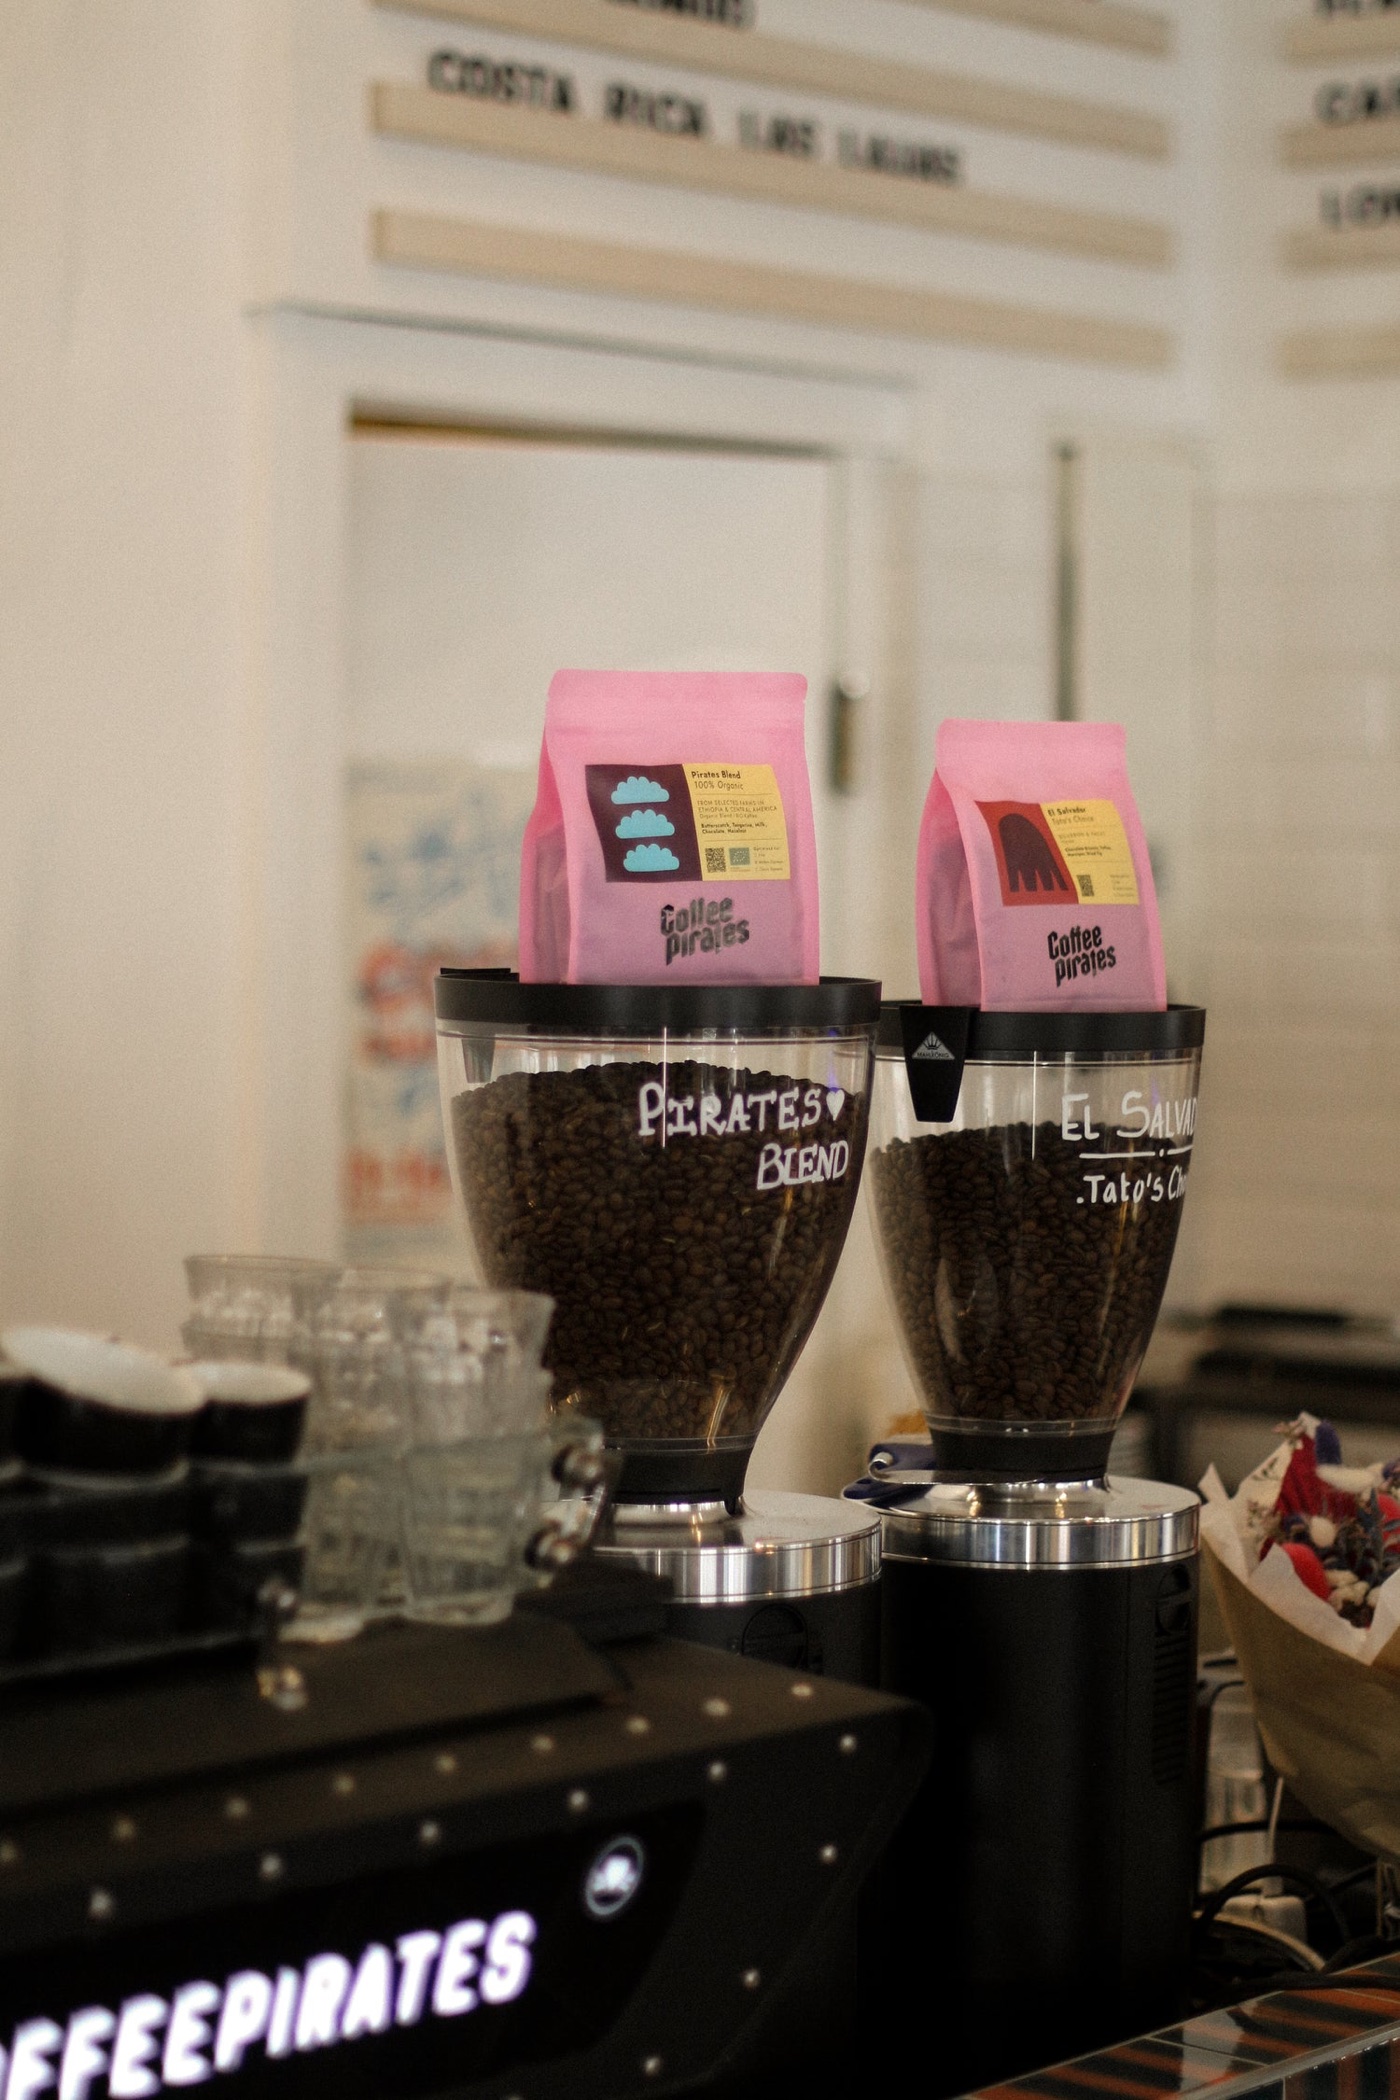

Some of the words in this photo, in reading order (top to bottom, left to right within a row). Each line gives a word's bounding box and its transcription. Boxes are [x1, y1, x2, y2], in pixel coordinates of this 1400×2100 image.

[428, 50, 573, 112] COSTA
[604, 80, 706, 138] RICA
[691, 771, 720, 779] Pirates
[721, 770, 741, 779] Blend
[694, 780, 714, 789] 100%
[717, 780, 744, 791] Organic
[661, 897, 733, 937] Coffee
[666, 920, 750, 966] pirates
[1047, 925, 1102, 960] Coffee
[1055, 945, 1117, 988] pirates
[637, 1082, 822, 1137] PIRATES
[1061, 1092, 1100, 1141] EL
[756, 1140, 849, 1190] BLEND
[0, 1910, 537, 2100] FFEEPIRATES
